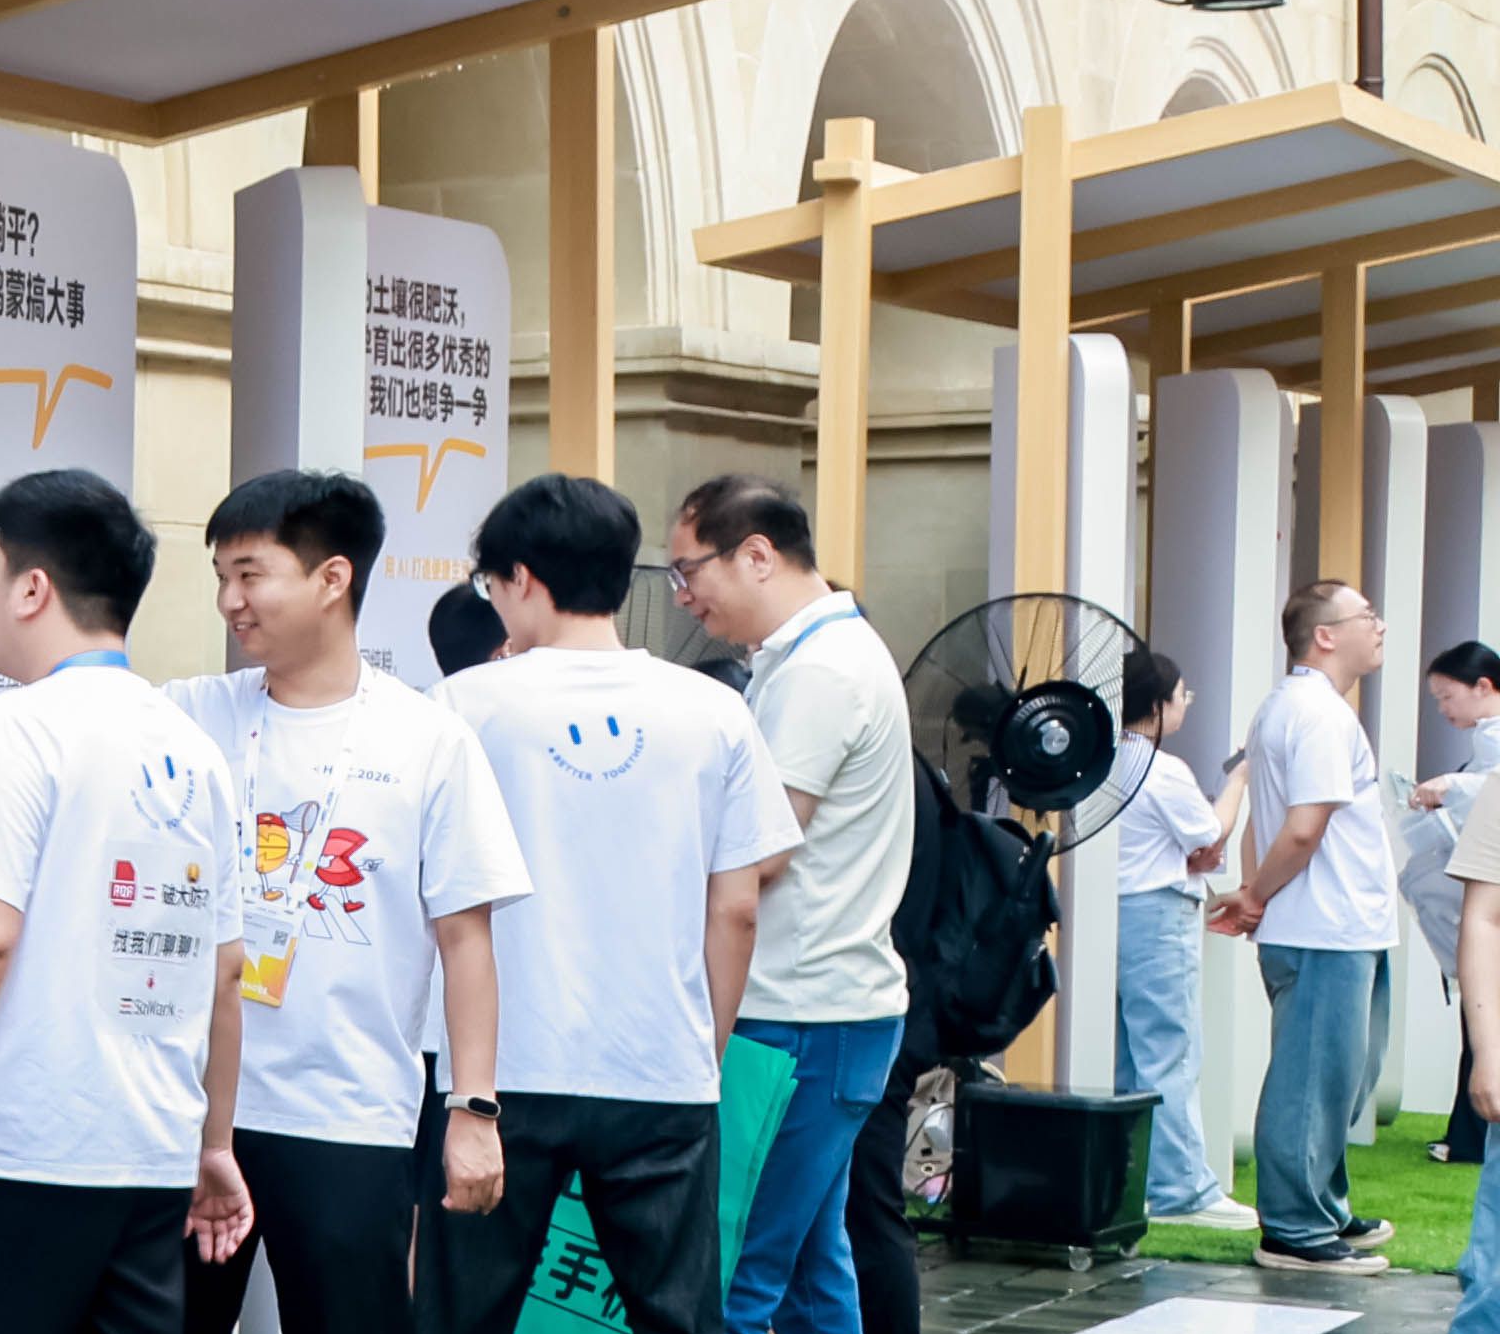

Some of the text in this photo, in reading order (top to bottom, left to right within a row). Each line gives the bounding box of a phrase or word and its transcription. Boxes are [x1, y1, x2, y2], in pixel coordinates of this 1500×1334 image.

[366, 274, 466, 329] 土壤很肥沃，
[369, 374, 488, 427] 我们也想争一争
